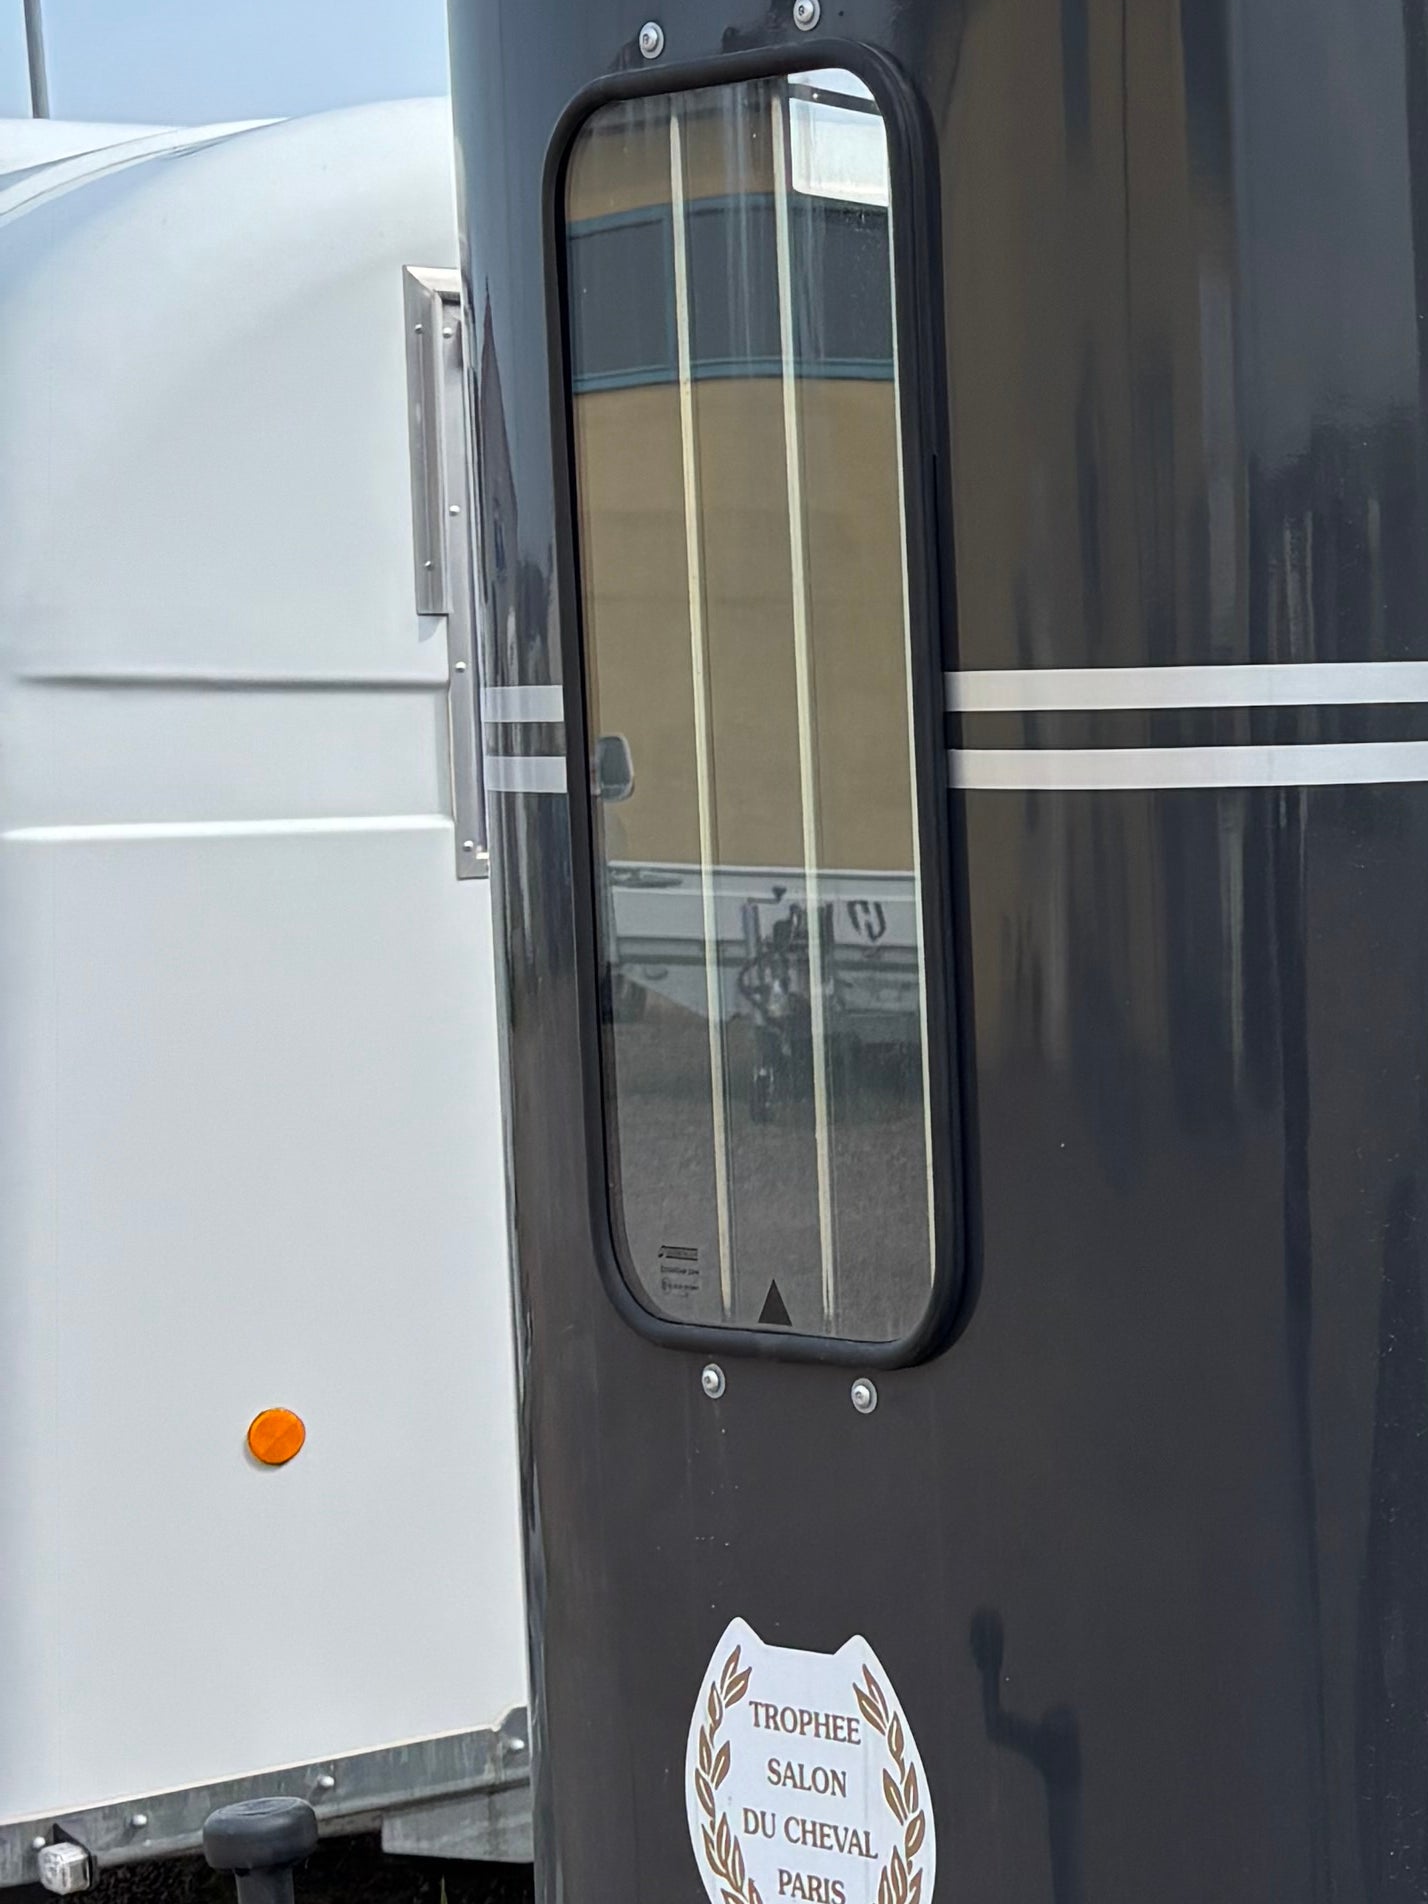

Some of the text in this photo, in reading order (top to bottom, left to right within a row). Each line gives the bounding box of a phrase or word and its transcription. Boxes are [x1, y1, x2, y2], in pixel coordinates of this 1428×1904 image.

[748, 1700, 862, 1745] TROPHEE
[767, 1757, 847, 1798] SALON
[742, 1807, 879, 1859] DU CHEVAL
